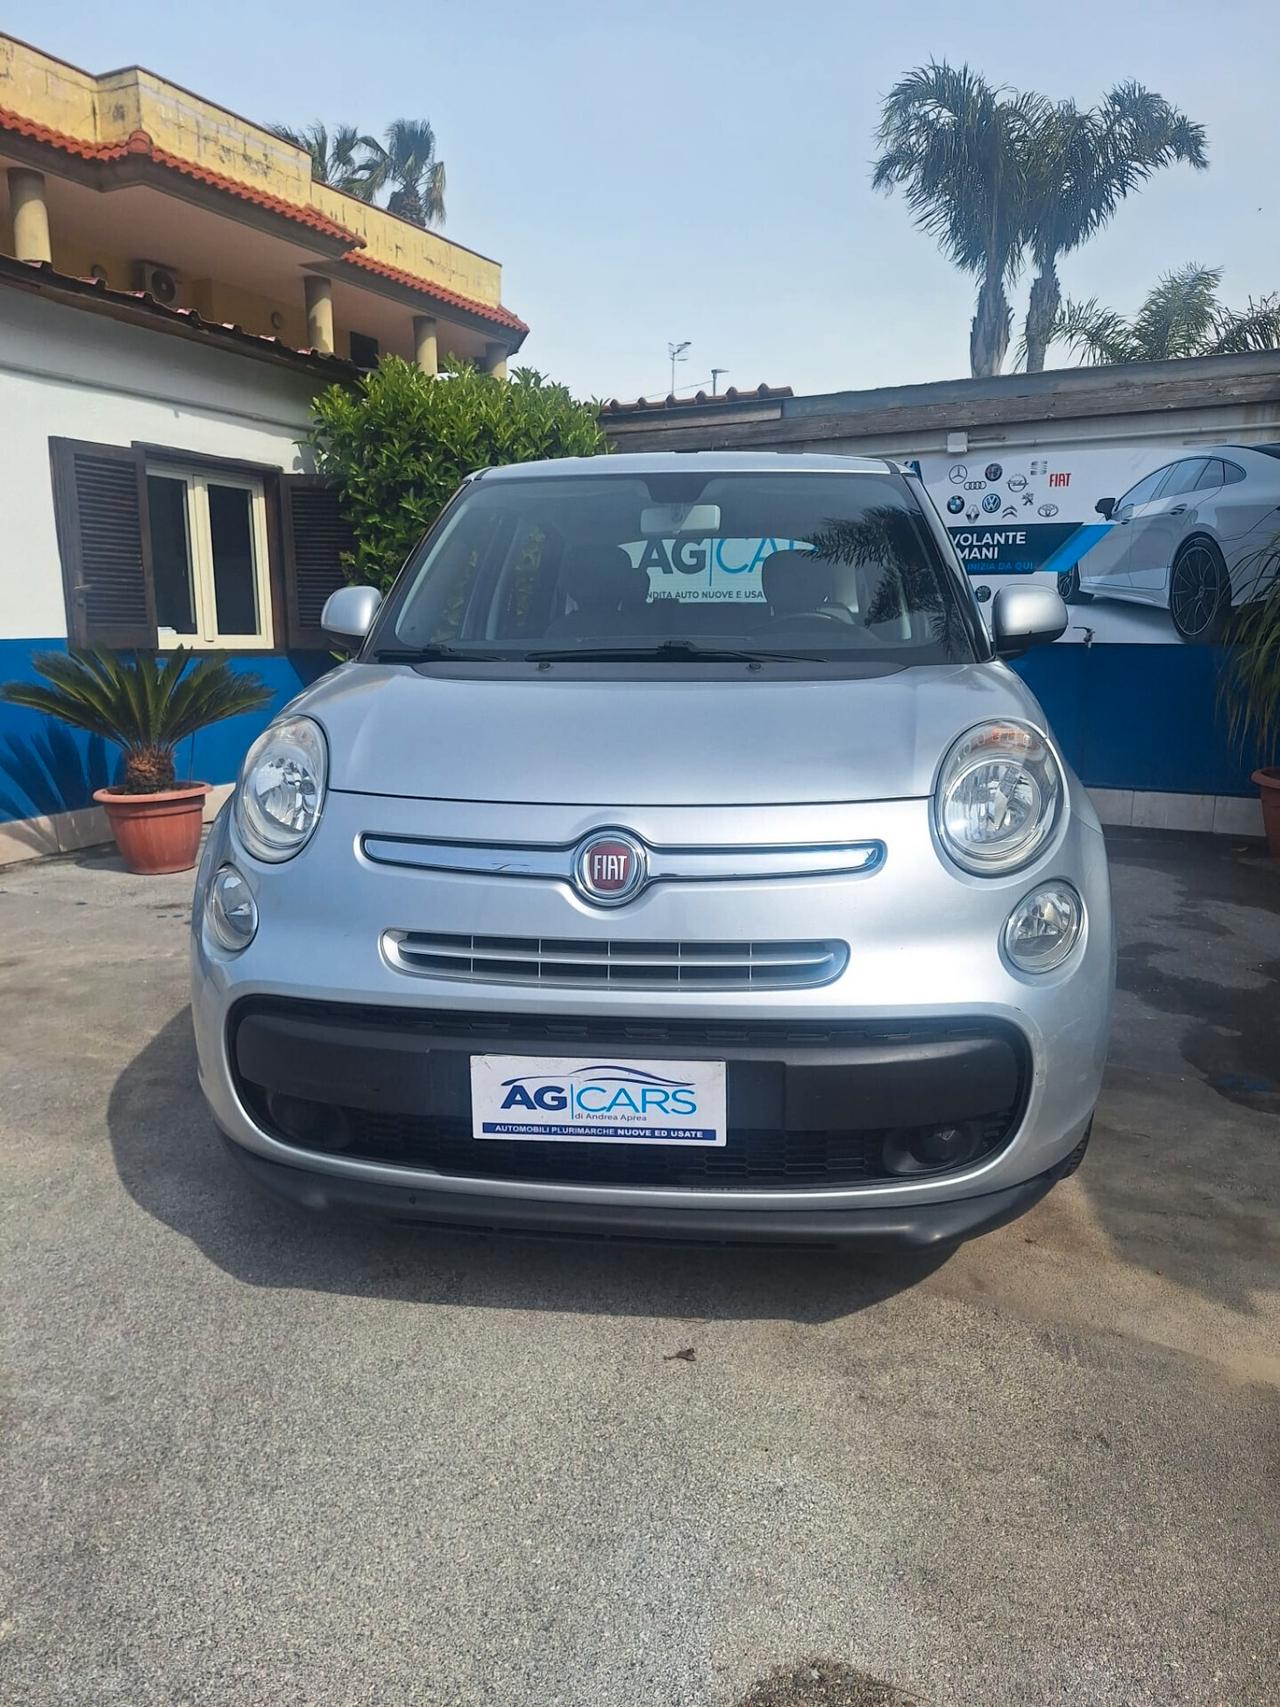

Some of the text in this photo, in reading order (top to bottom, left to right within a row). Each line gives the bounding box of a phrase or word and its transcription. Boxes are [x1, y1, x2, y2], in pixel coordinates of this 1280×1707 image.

[1049, 473, 1072, 488] FIAT
[950, 531, 1027, 546] VOLANTE
[640, 537, 795, 575] AG CA
[957, 546, 999, 560] MANI
[967, 561, 1034, 571] INIZIA DA QUI
[675, 590, 700, 600] AUTO
[702, 590, 734, 599] NUOVE
[736, 590, 742, 599] E
[593, 854, 628, 880] FIAT
[500, 1084, 698, 1116] AG CARS
[574, 1112, 647, 1122] di Andrea Aprea
[495, 1124, 704, 1139] AUTOMOBILI PLURIMARCHE NUOVE ED USATE
